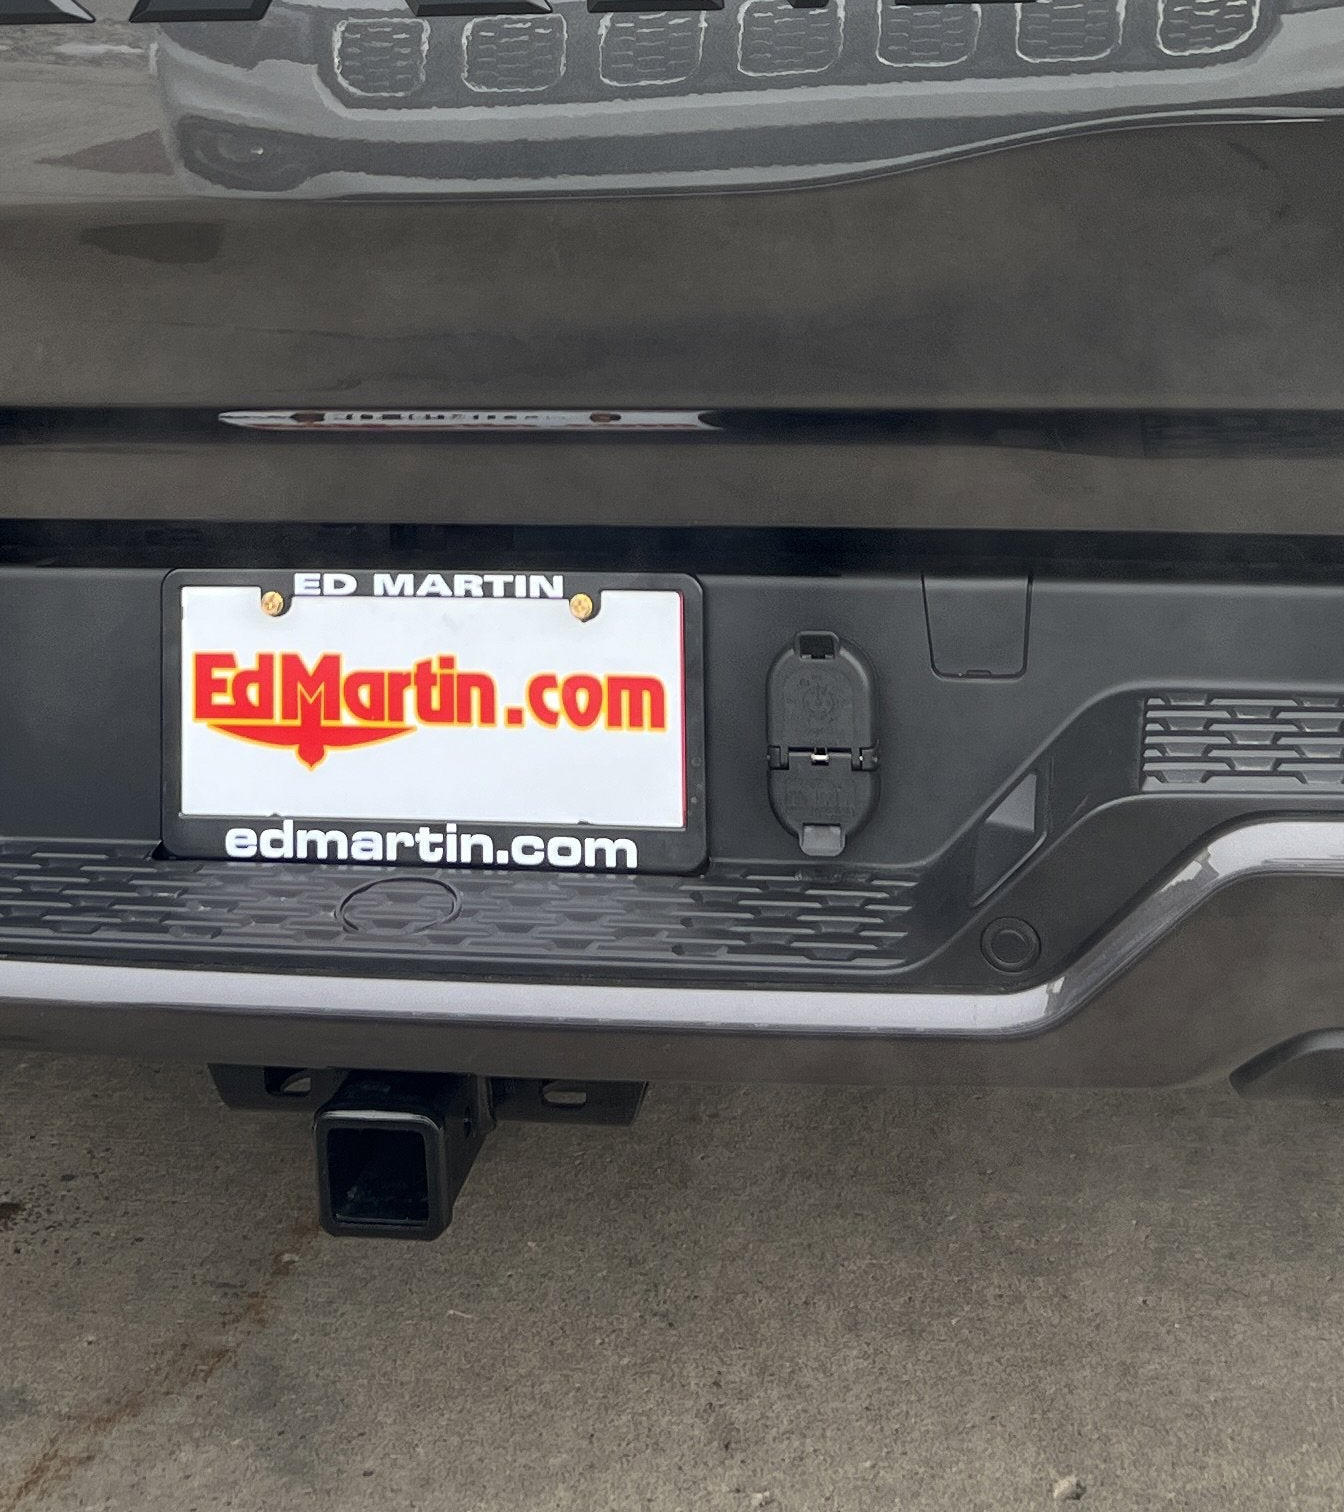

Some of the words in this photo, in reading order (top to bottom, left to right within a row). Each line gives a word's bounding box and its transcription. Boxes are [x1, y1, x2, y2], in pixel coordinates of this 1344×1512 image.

[293, 572, 358, 597] ED
[373, 573, 564, 599] MARTIN
[192, 651, 667, 731] EdMartin.com
[224, 820, 639, 869] edmartin.com
